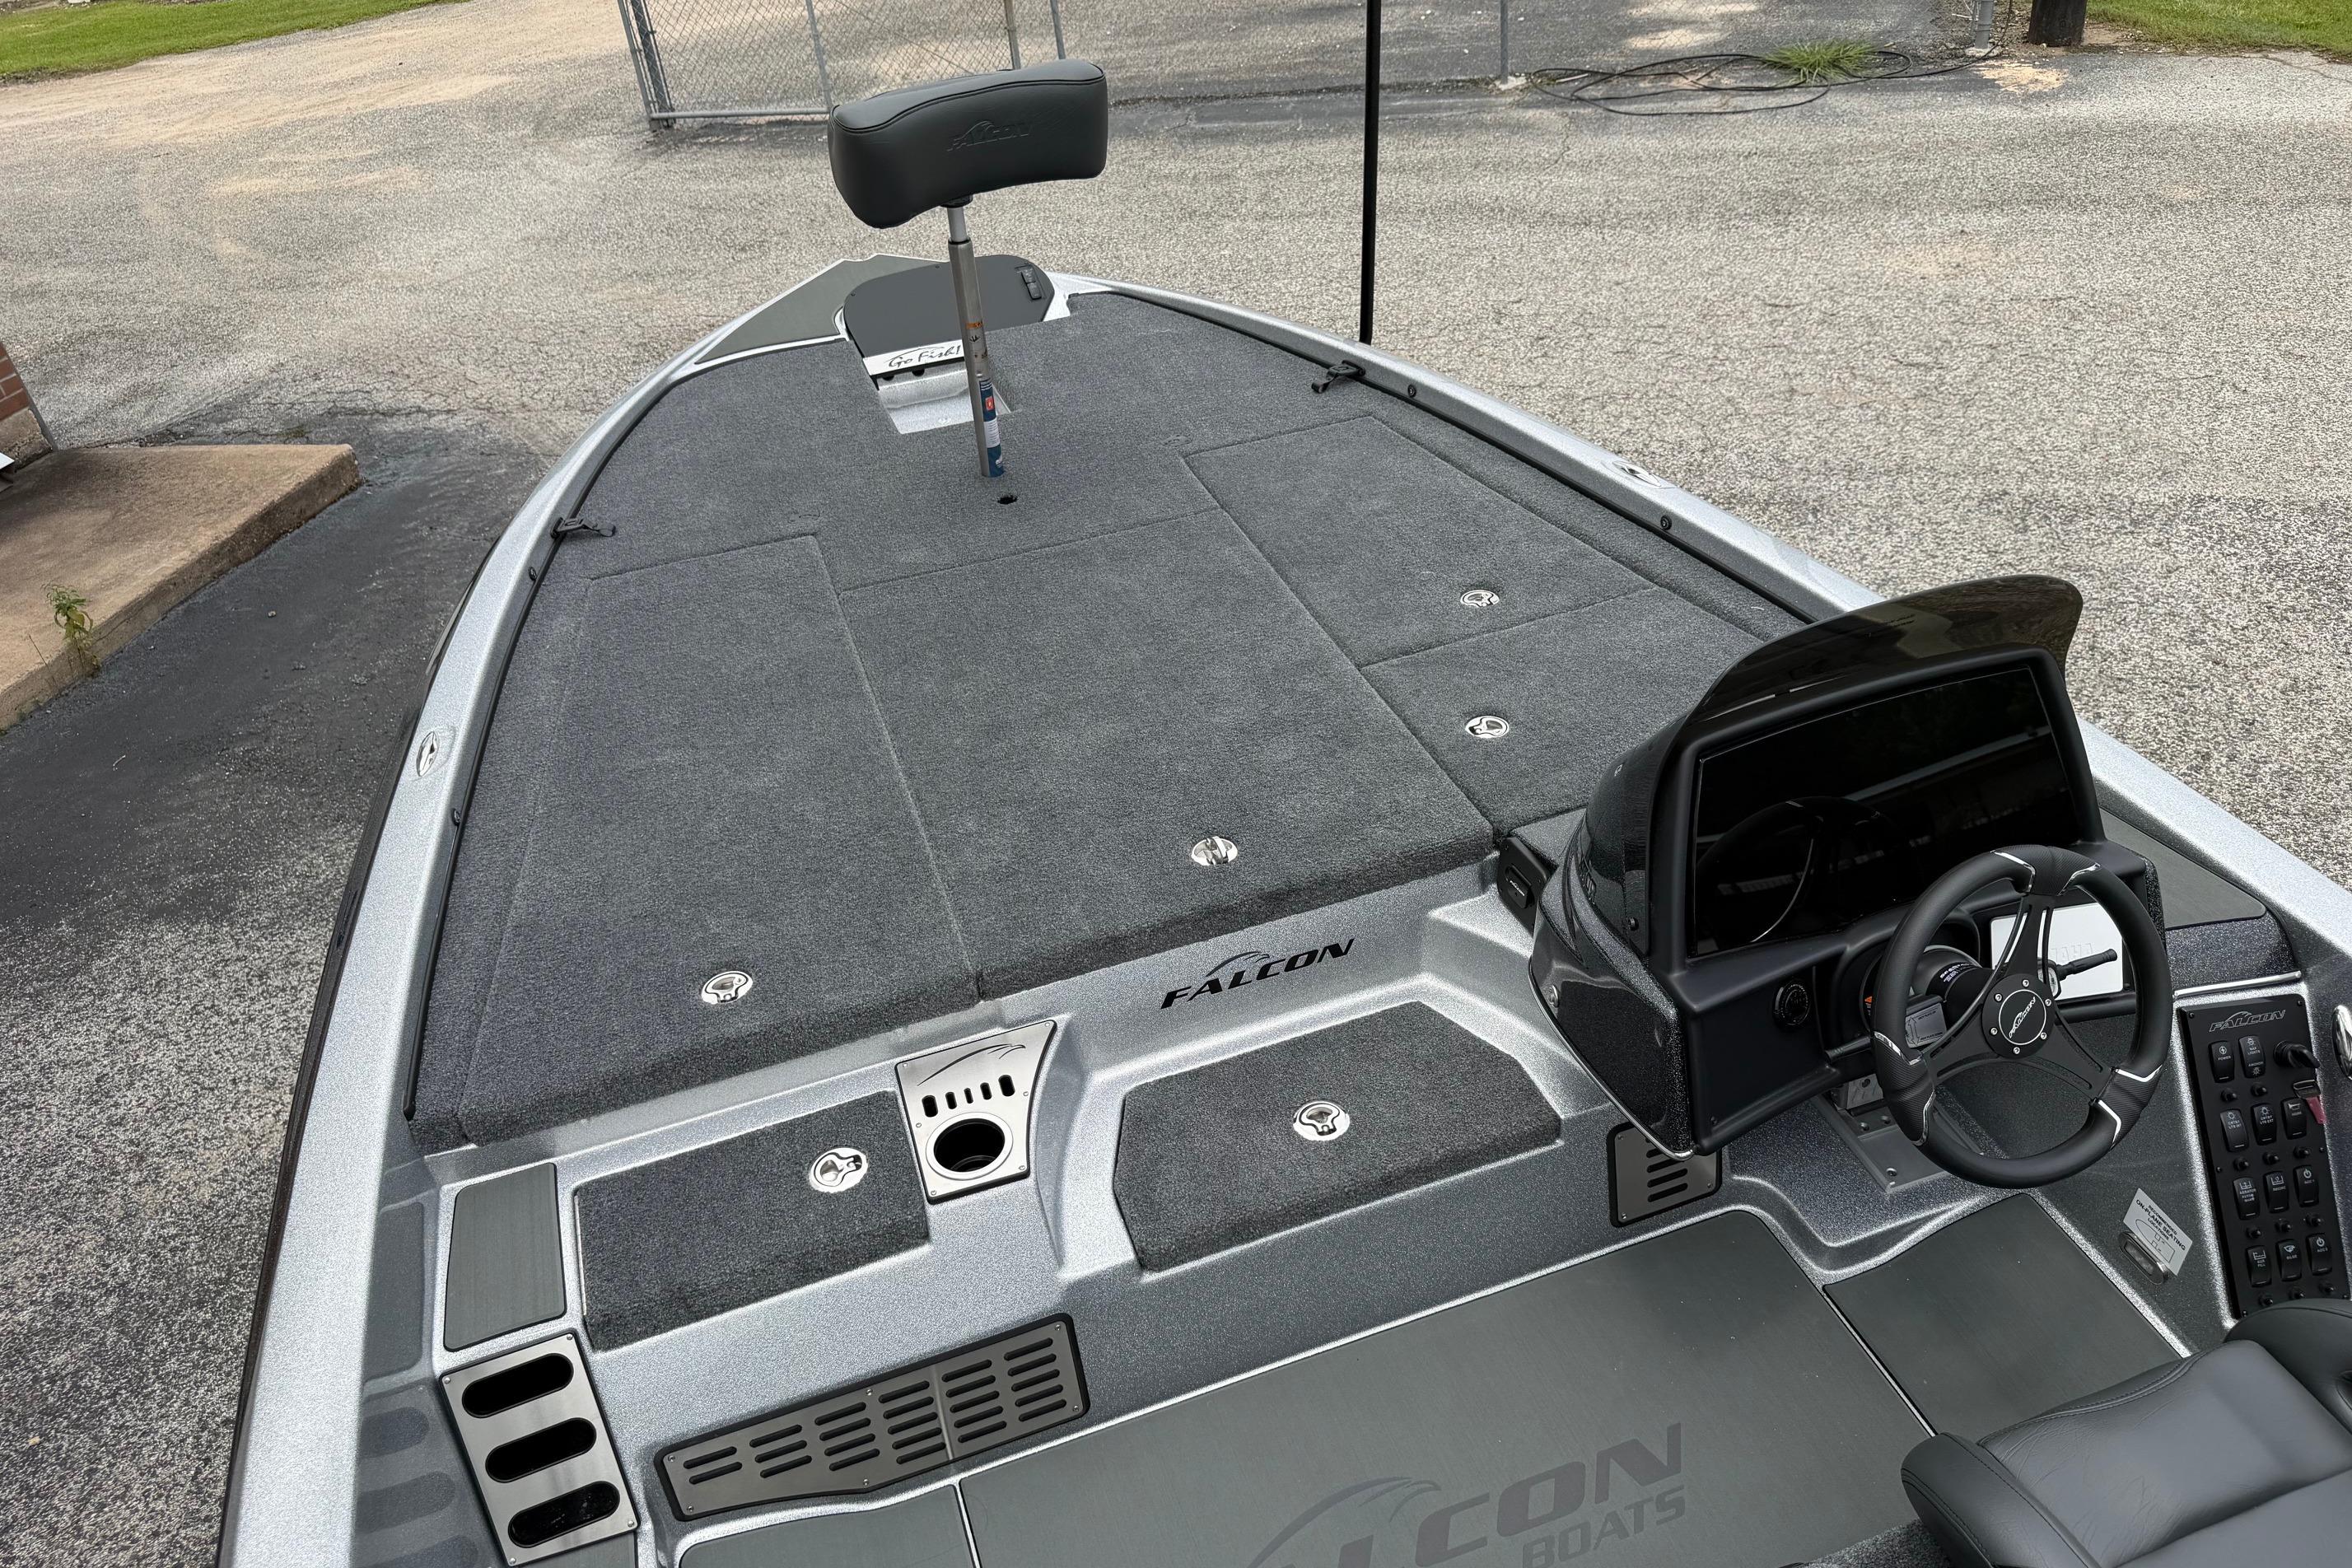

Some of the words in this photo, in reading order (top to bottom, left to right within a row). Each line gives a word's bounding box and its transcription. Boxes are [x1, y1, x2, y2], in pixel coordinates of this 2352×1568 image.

[889, 357, 913, 368] Go
[1160, 938, 1355, 1009] FALCON
[2009, 996, 2036, 1038] FALCON
[2209, 1009, 2286, 1033] FALCON
[2136, 1199, 2163, 1226] ON-PLANE
[2163, 1225, 2186, 1251] SEATING
[2148, 1217, 2170, 1240] LOCATIONS
[1522, 1485, 1686, 1568] BOATS
